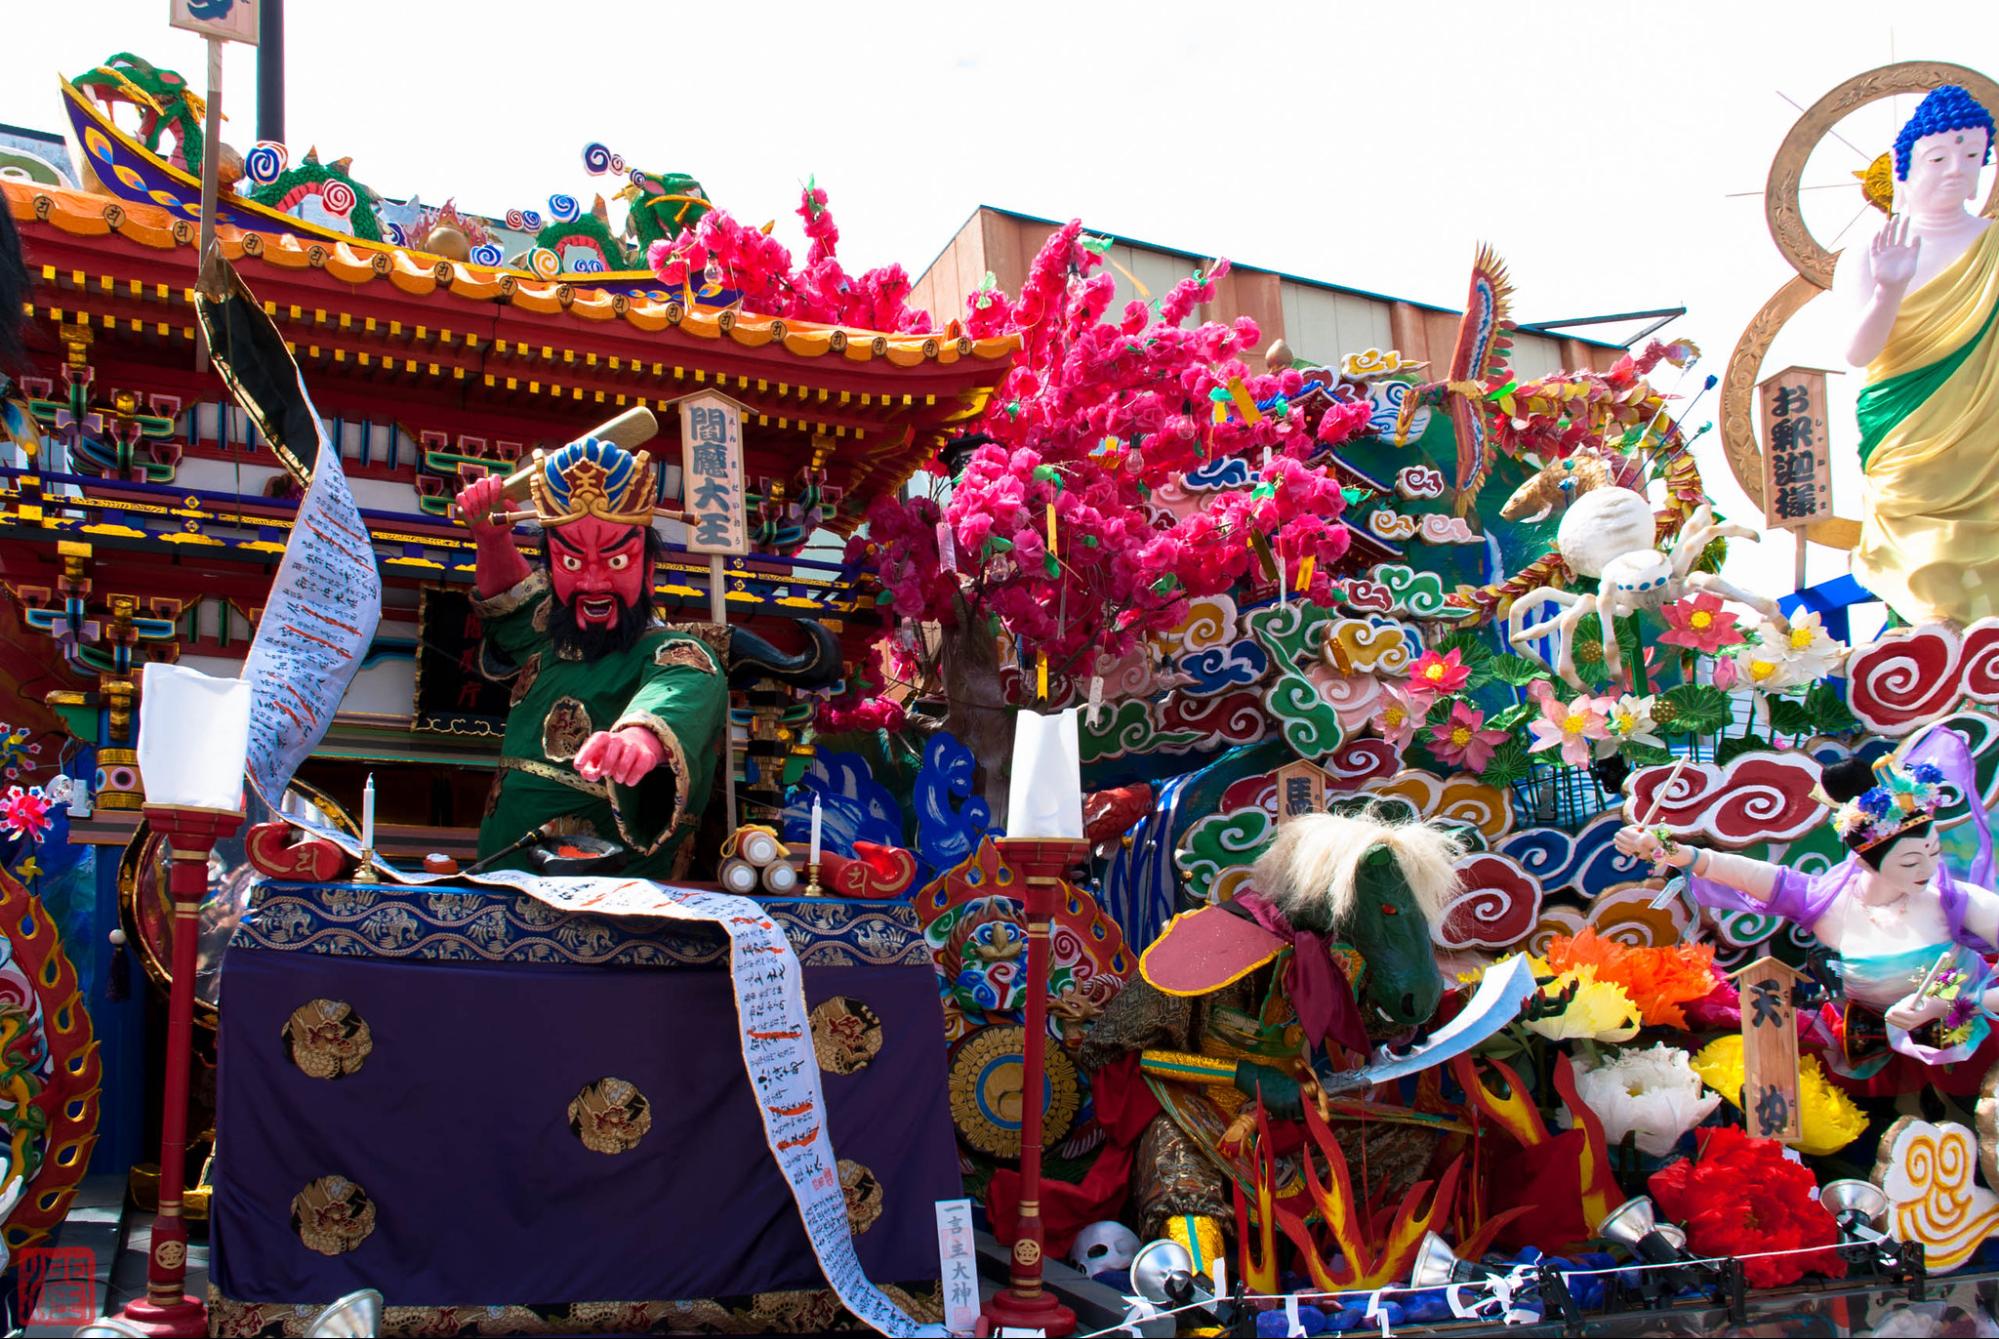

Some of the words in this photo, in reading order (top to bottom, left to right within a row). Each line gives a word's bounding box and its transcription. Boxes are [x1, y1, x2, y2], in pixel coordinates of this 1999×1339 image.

[690, 406, 732, 547] 閻魔大王
[1772, 385, 1817, 519] お釈迦様
